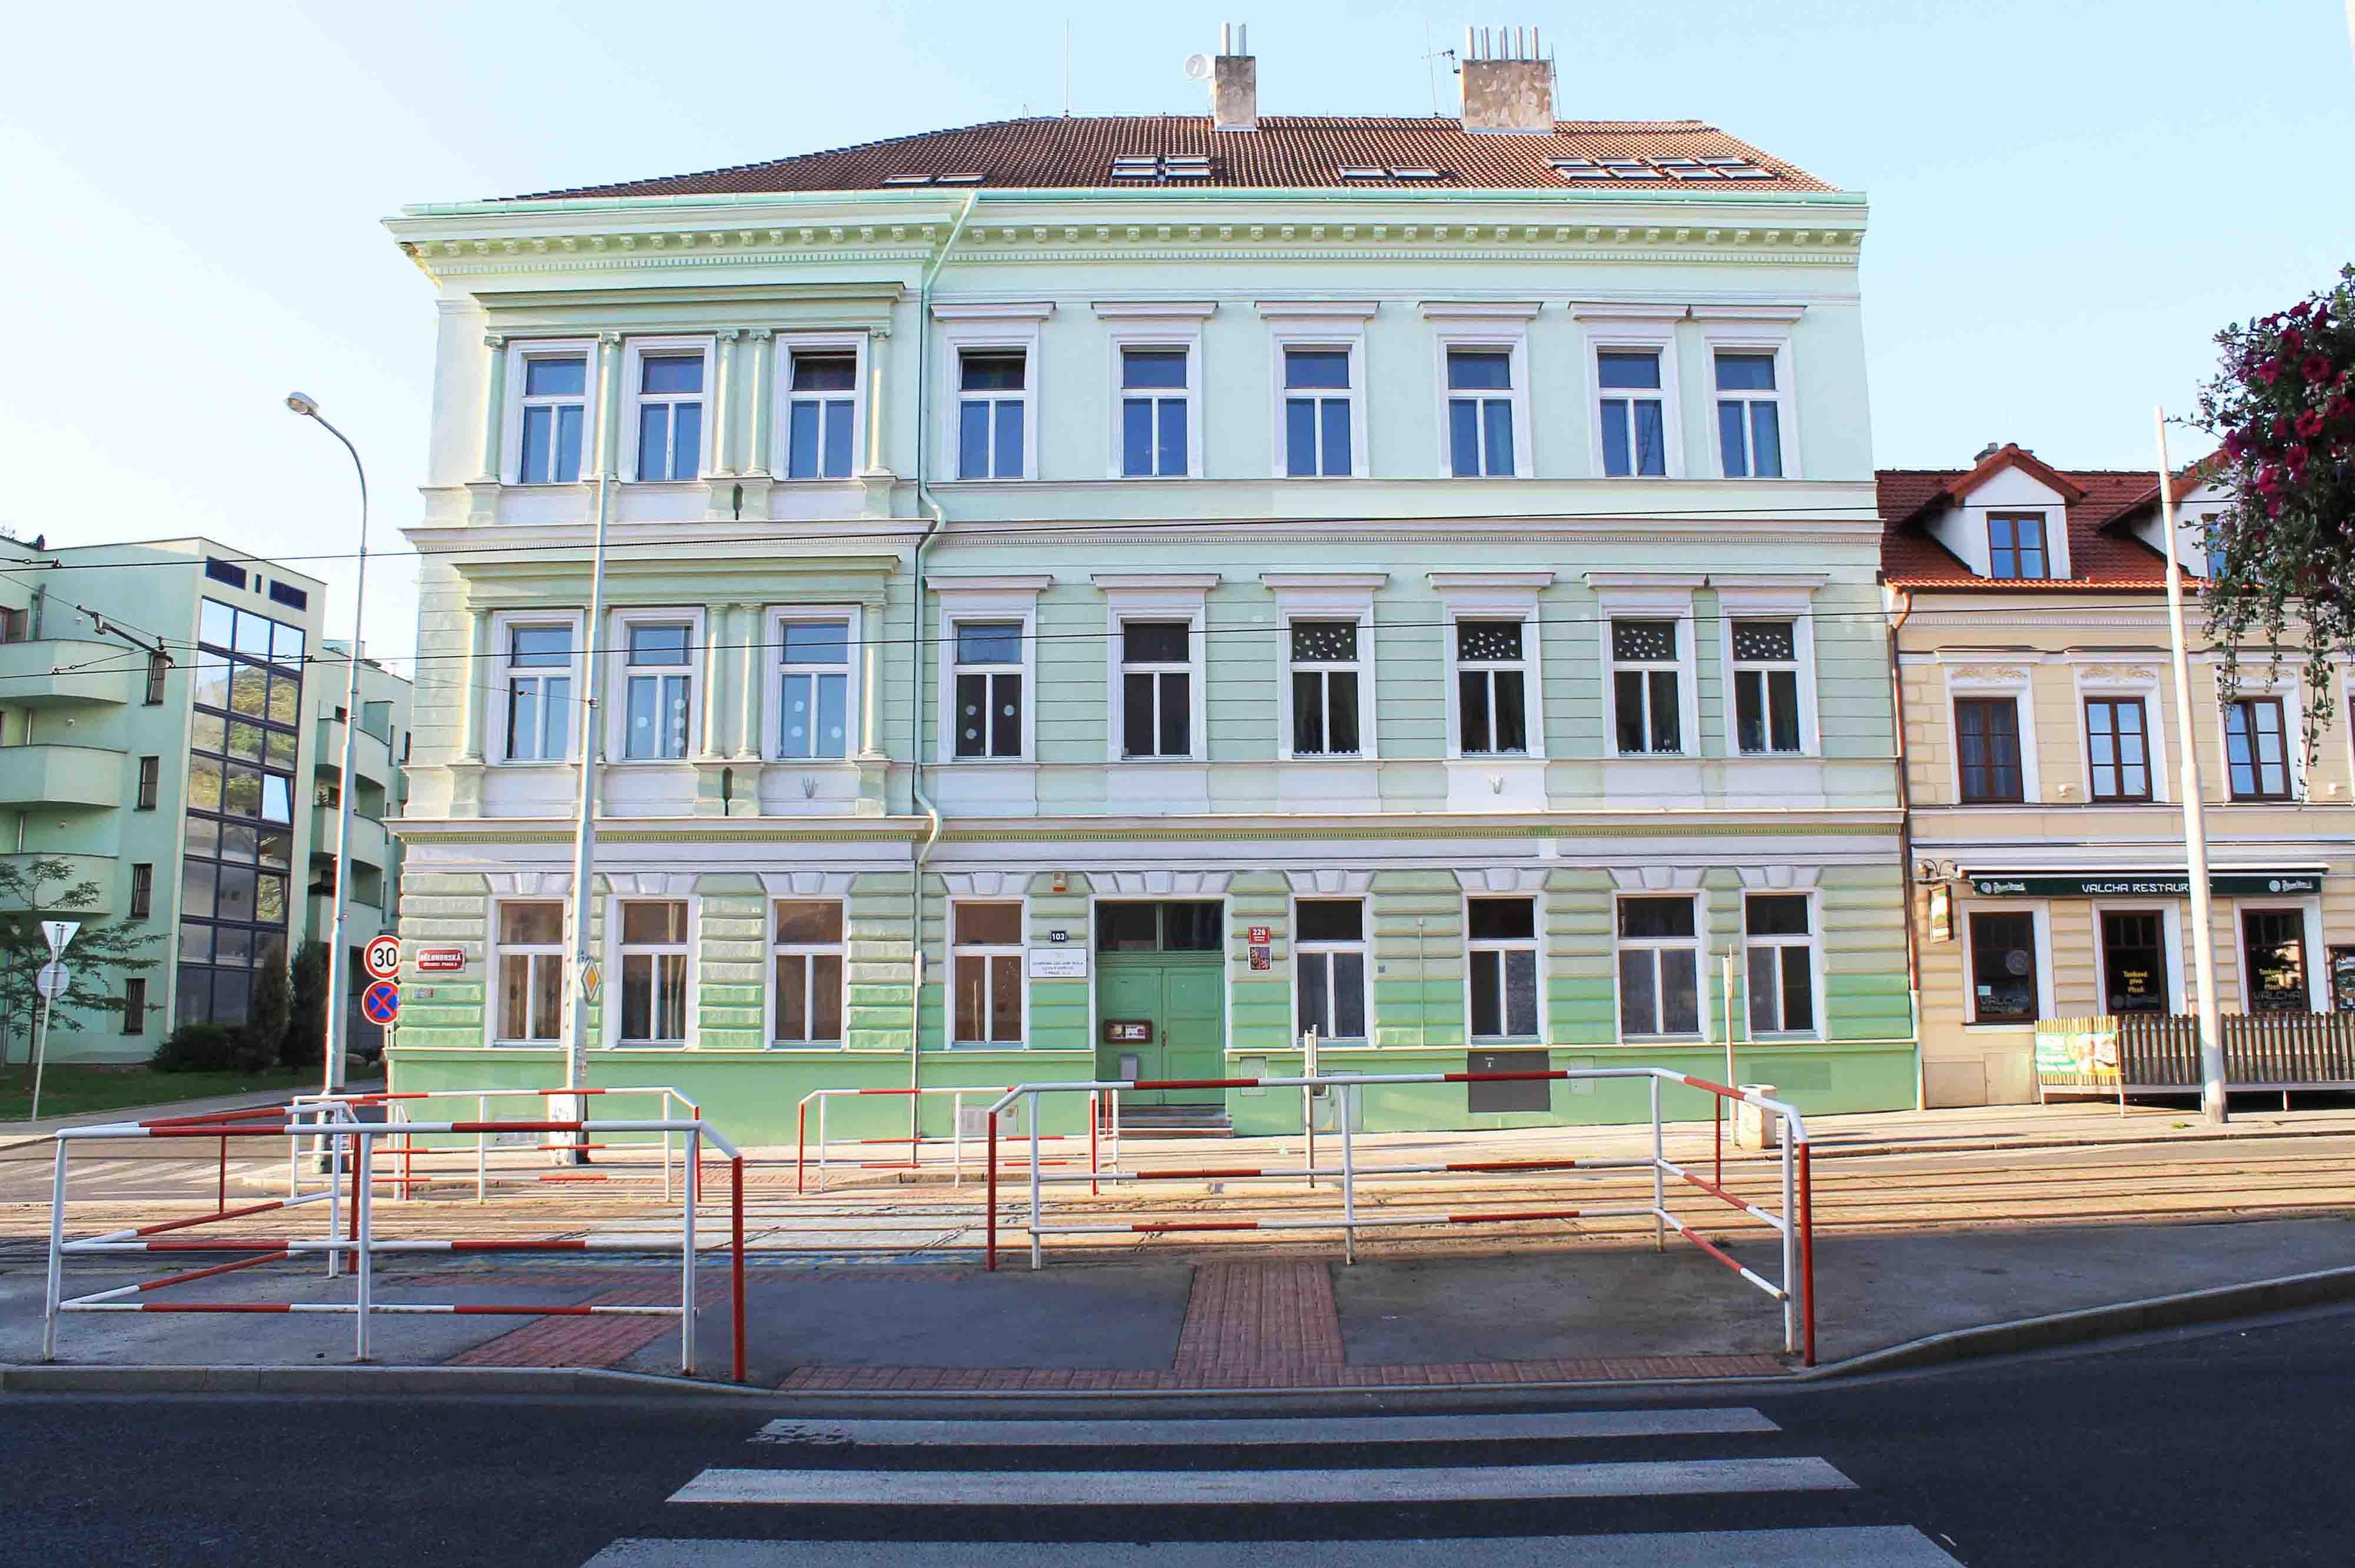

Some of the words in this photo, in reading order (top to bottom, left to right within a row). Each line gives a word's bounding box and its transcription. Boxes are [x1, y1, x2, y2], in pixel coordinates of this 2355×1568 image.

[2082, 883, 2128, 892] VALCHA
[2132, 883, 2213, 892] RESTAUR
[374, 948, 396, 967] 30
